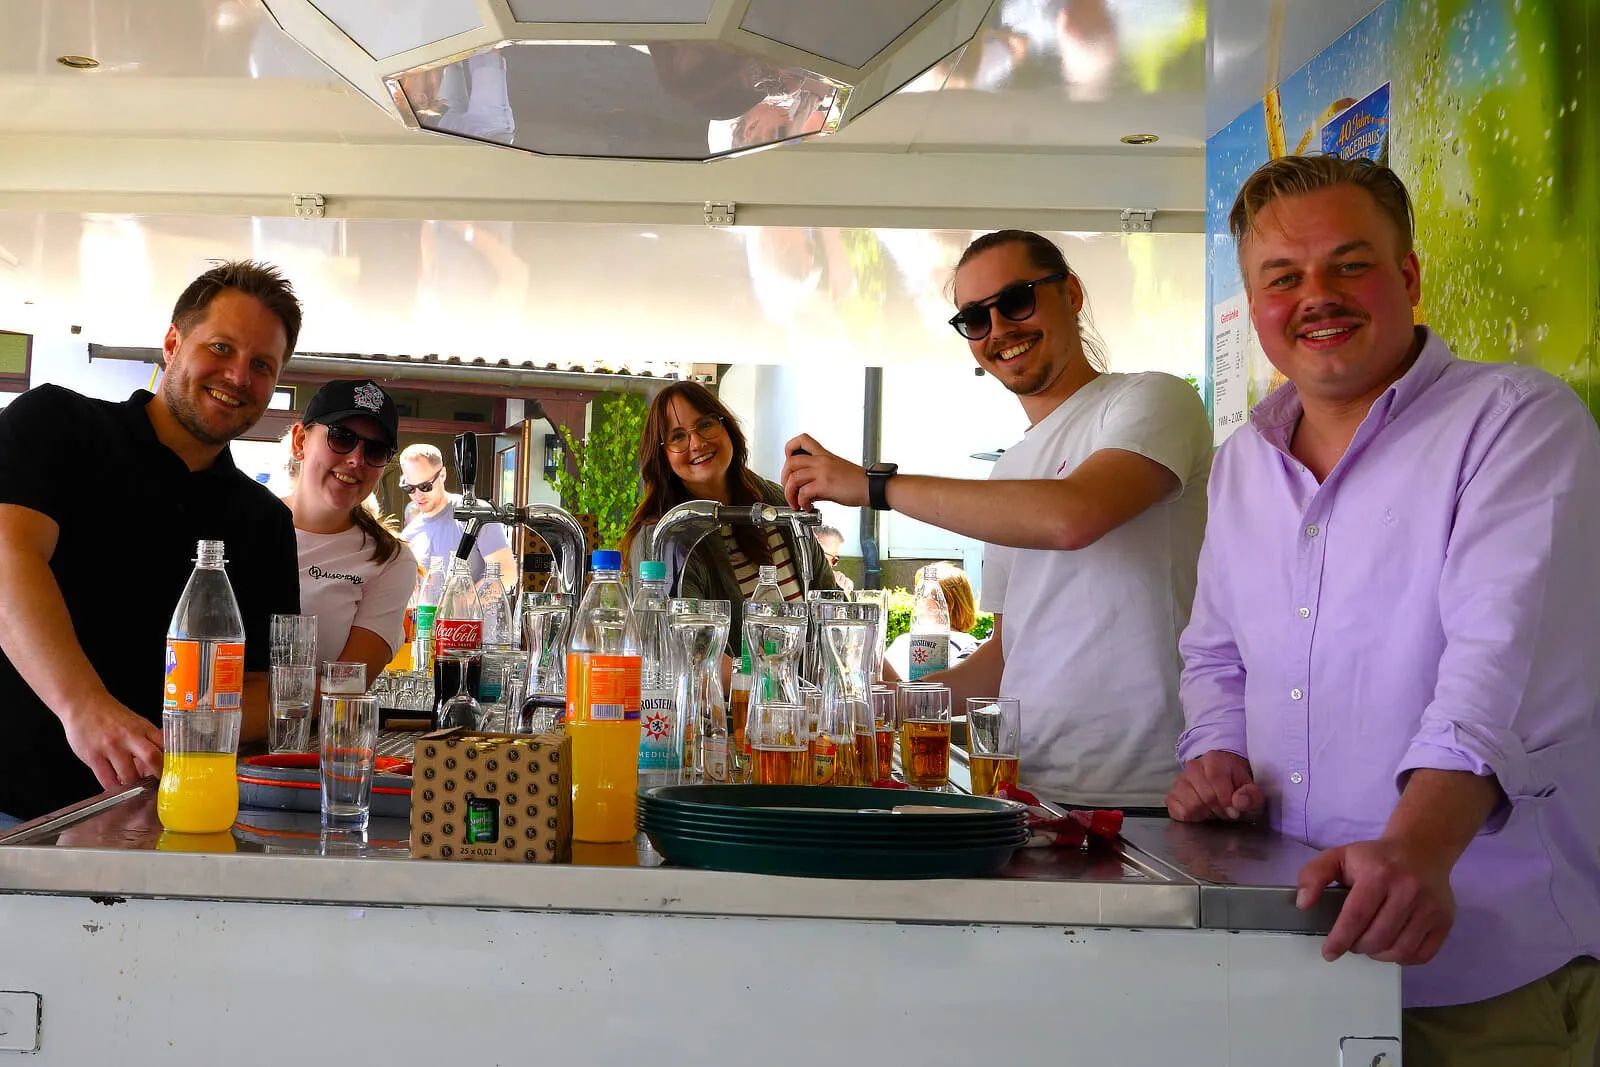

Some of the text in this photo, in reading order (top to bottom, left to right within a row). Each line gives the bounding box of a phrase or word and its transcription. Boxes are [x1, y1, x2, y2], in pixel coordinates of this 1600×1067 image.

[1340, 128, 1381, 160] ÜRGERHAUS
[460, 847, 469, 855] 25
[477, 848, 493, 857] 0,02
